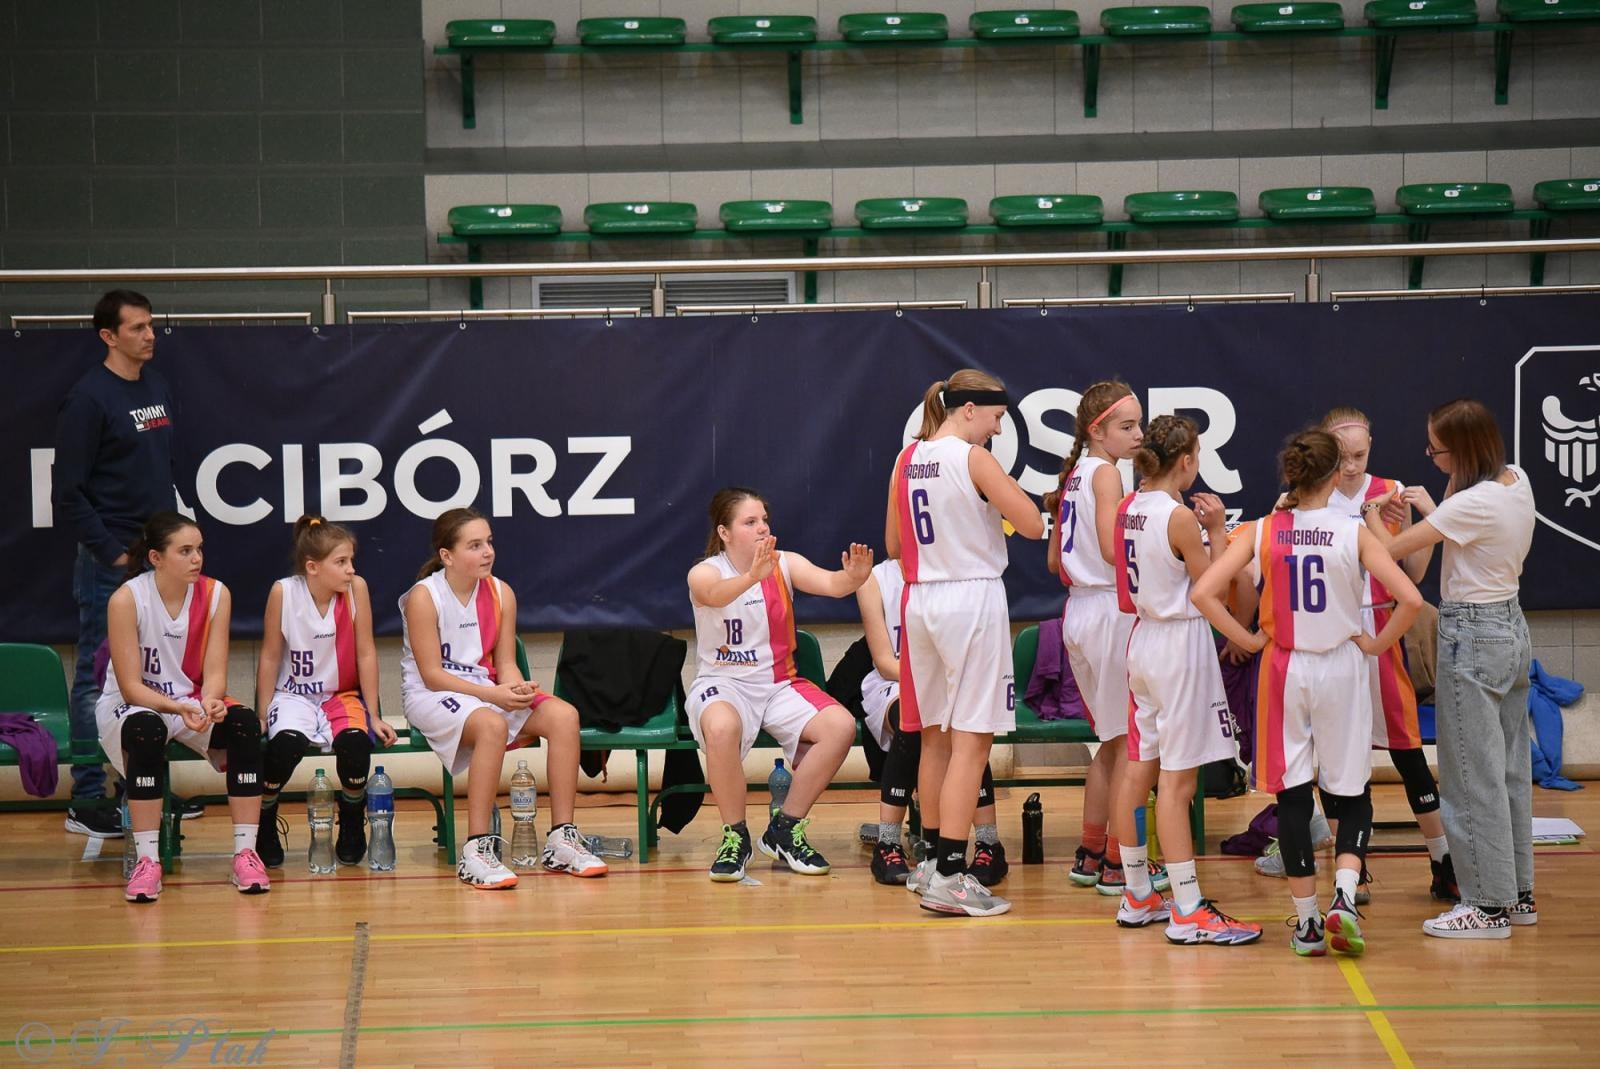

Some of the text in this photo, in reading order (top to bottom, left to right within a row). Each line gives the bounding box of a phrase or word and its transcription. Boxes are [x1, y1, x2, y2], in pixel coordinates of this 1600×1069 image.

[129, 404, 167, 423] TOMMY
[903, 386, 1243, 497] OSR
[31, 411, 635, 529] CIBÓRZ
[902, 461, 940, 480] RACIBÓRZ
[912, 487, 935, 546] 6
[1277, 526, 1334, 547] RACIBÓRZ
[1124, 538, 1140, 594] 5
[1284, 553, 1327, 613] 16
[723, 618, 743, 645] 18
[143, 646, 162, 675] 13
[290, 649, 314, 678] 55
[715, 646, 758, 663] MINI
[284, 674, 324, 696] MINI
[700, 686, 720, 703] 18
[1006, 683, 1016, 711] 6
[441, 697, 461, 714] 9
[1217, 708, 1233, 738] 5
[142, 777, 155, 787] NBA
[244, 773, 256, 784] NBA
